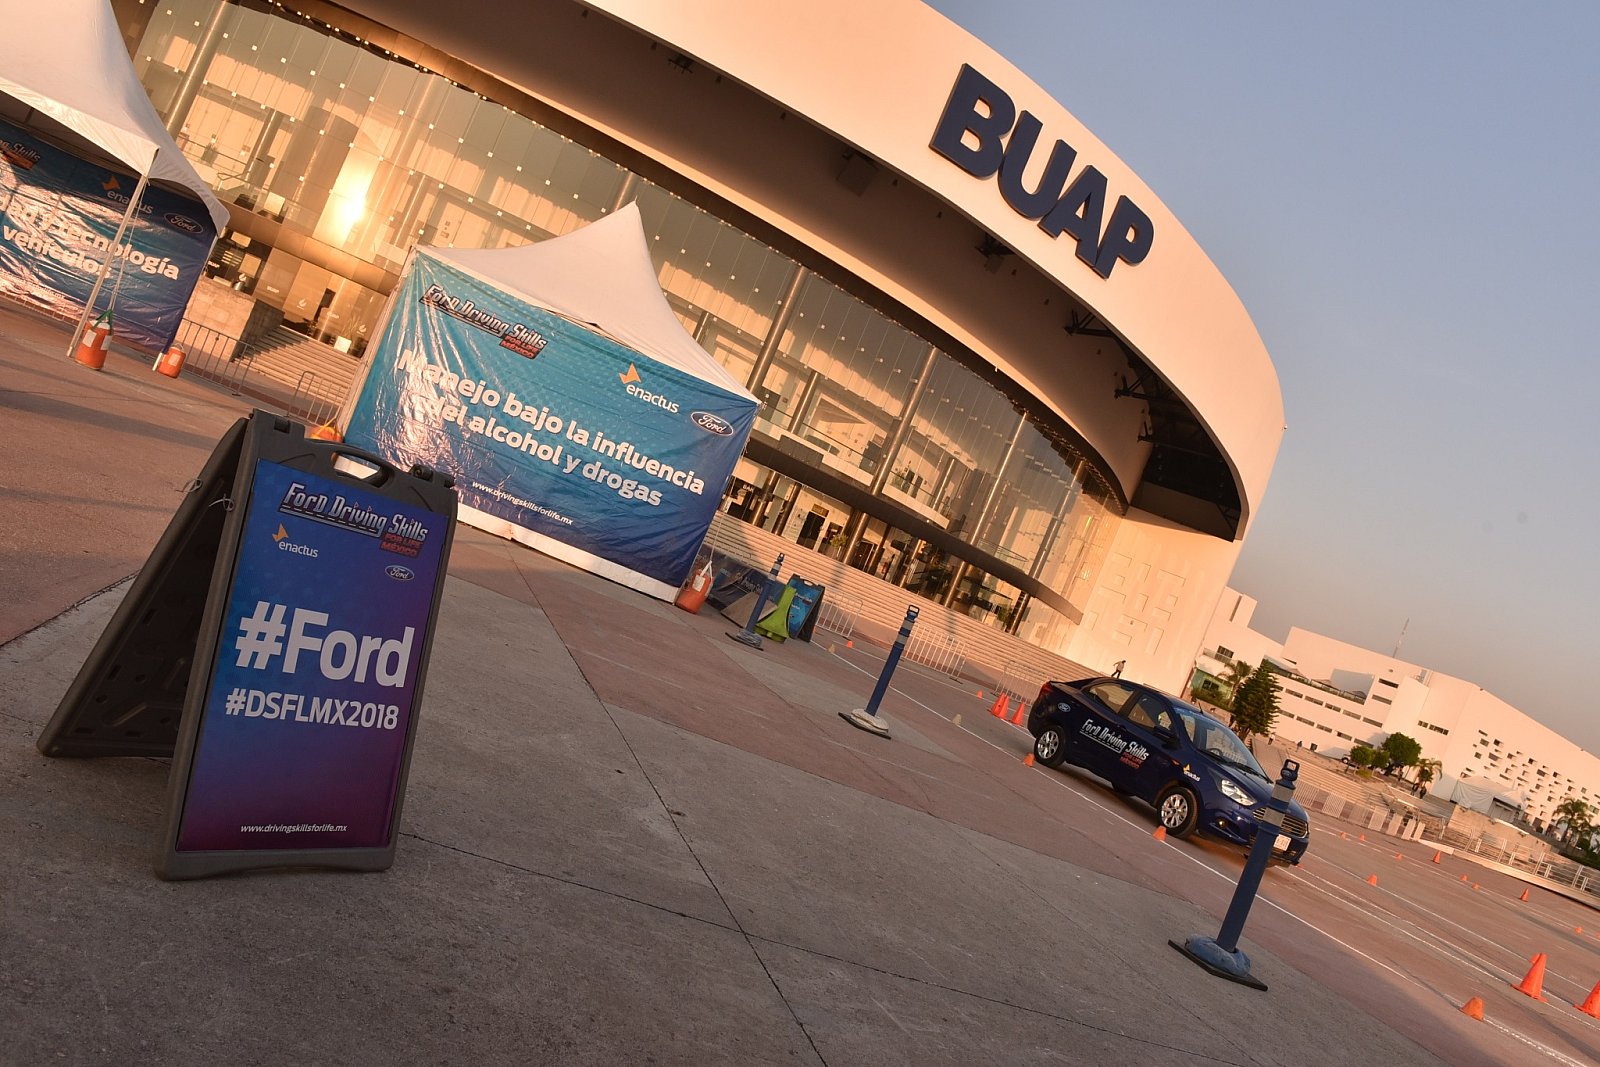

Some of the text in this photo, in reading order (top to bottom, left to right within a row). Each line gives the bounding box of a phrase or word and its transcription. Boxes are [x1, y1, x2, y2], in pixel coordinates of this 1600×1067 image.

[928, 63, 1154, 280] BUAP
[461, 301, 509, 336] Driving
[510, 323, 547, 349] Skills
[398, 348, 705, 495] Manejo bajo la influencia
[626, 384, 680, 413] enactus
[430, 396, 663, 506] del alcohol y drogas
[329, 495, 387, 538] Driving
[387, 514, 428, 542] Skills
[472, 481, 574, 526] www.drivingskillsforlife.mx
[278, 540, 318, 558] enactus
[235, 600, 415, 688] #Ford
[225, 687, 399, 730] #DSFLMX2018
[1100, 727, 1127, 753] Driving
[1125, 741, 1149, 760] Skills
[240, 823, 348, 834] www.drivingskillsforlife.mx
